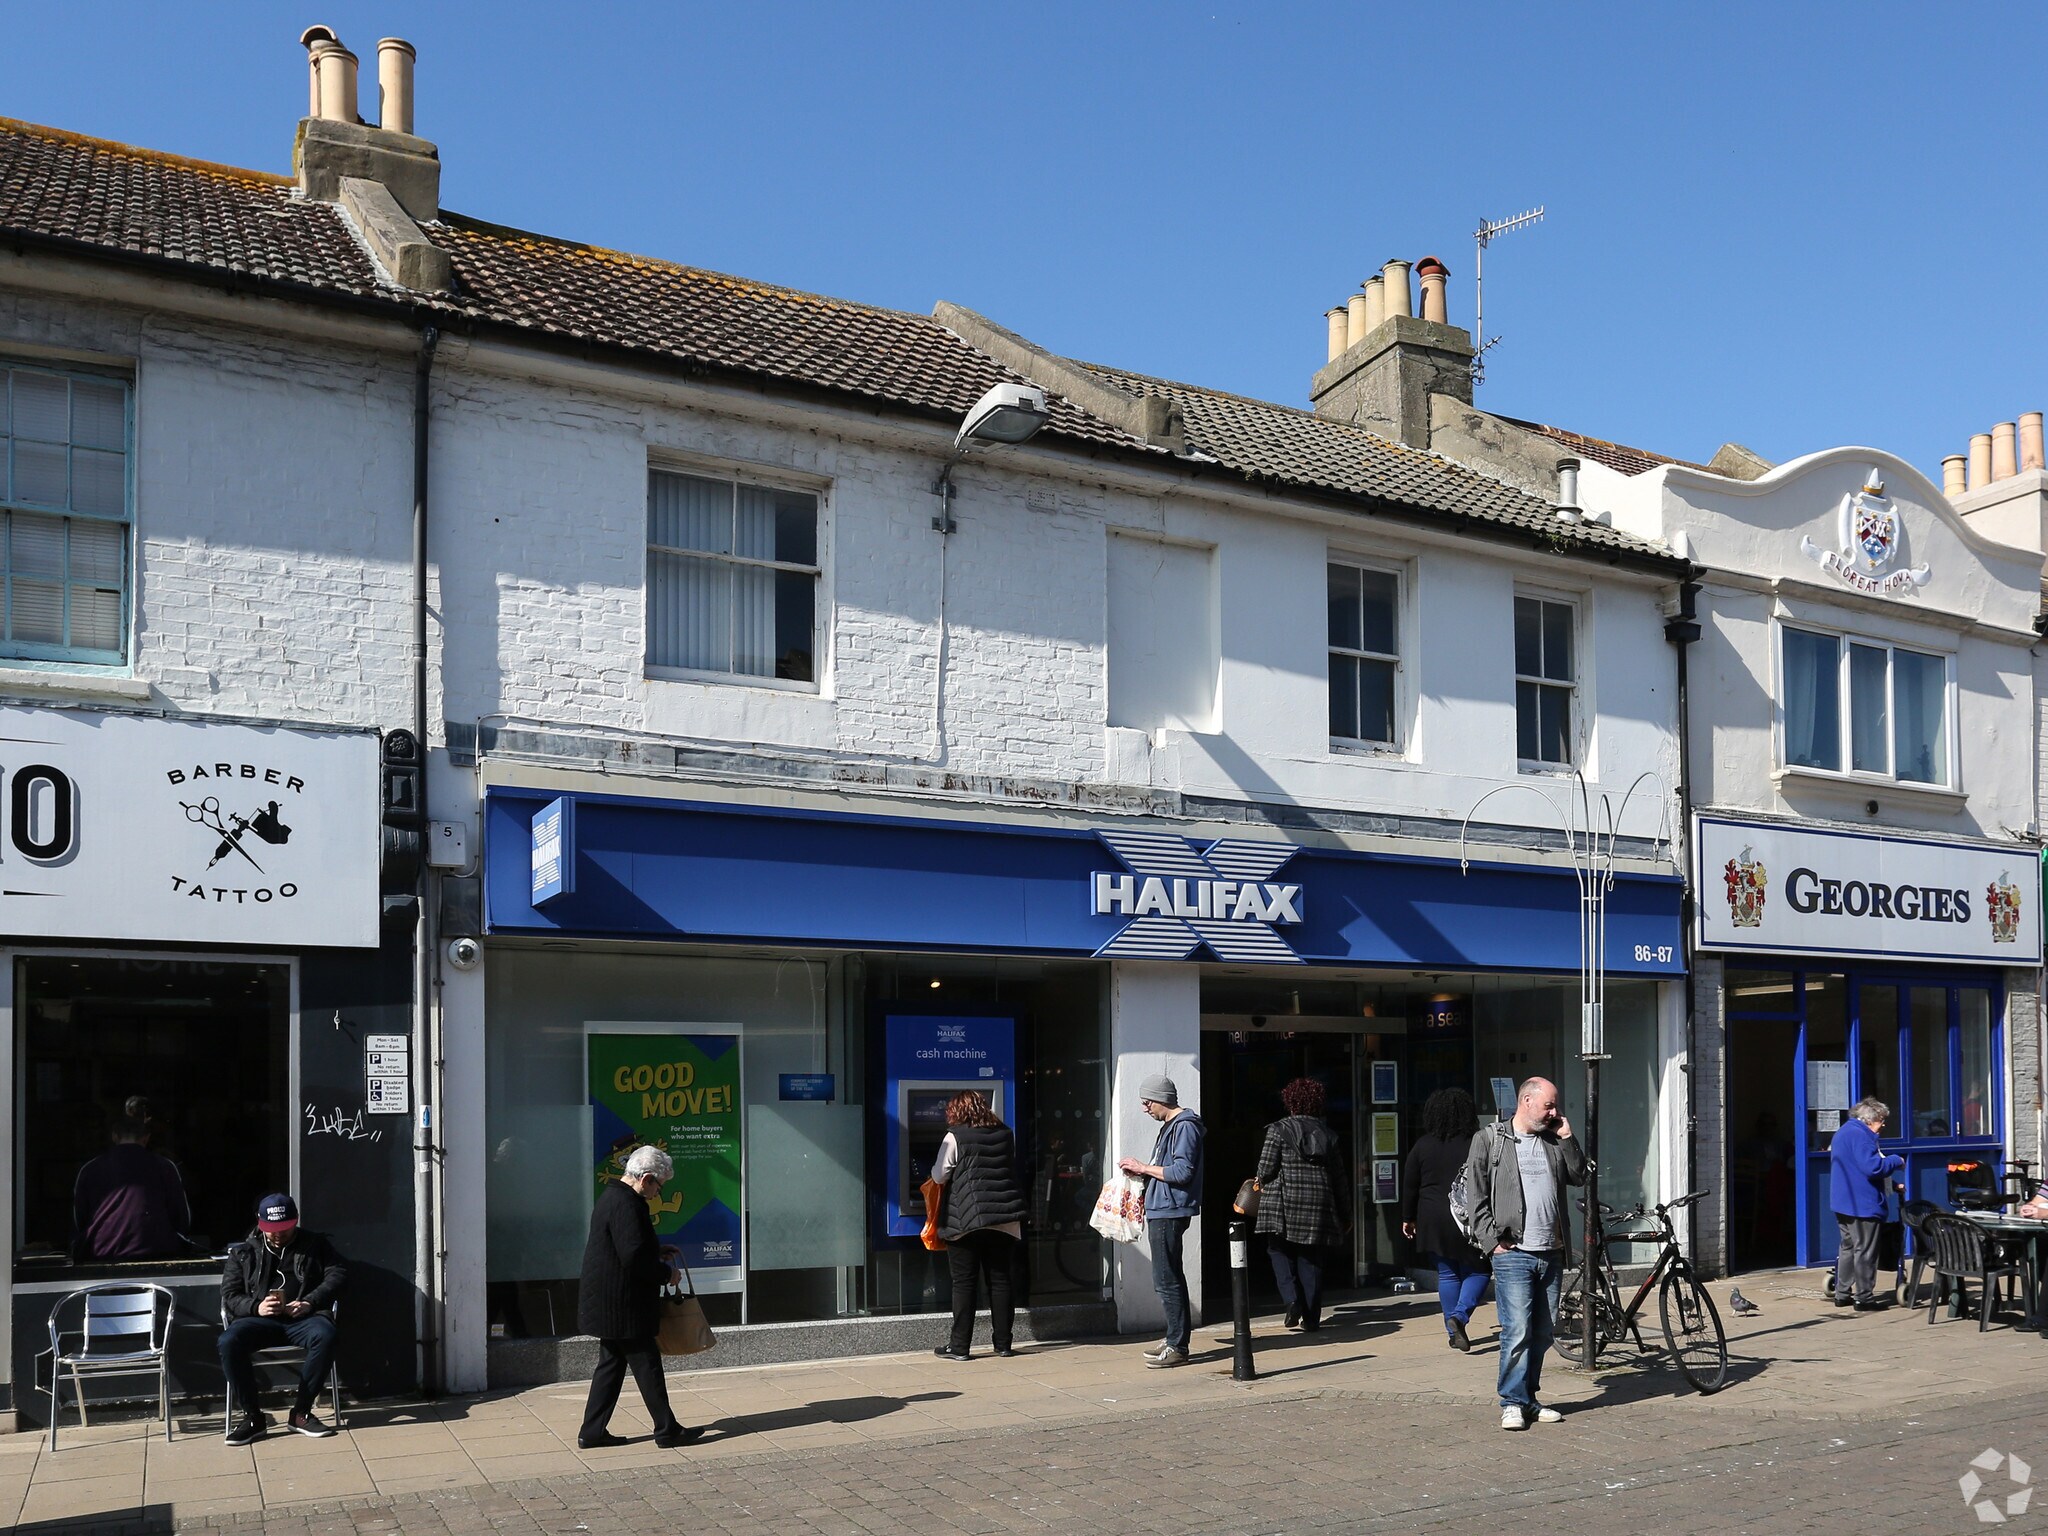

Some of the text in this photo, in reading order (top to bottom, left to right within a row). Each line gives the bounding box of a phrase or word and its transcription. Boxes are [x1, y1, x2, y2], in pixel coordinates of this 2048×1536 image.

[1828, 553, 1912, 593] FLOREAT HOVA
[166, 763, 305, 794] BARBER
[0, 764, 81, 868] O
[444, 826, 452, 837] 5
[171, 875, 298, 904] TATTOO
[1096, 874, 1302, 923] HALIFAX
[1785, 868, 1972, 924] GEORGIES
[1633, 944, 1672, 963] 86-87
[1426, 1013, 1435, 1028] a
[372, 1055, 379, 1063] P
[916, 1048, 986, 1058] cash machine
[372, 1081, 380, 1089] P
[614, 1062, 694, 1092] GOOD
[642, 1084, 732, 1119] MOVE!
